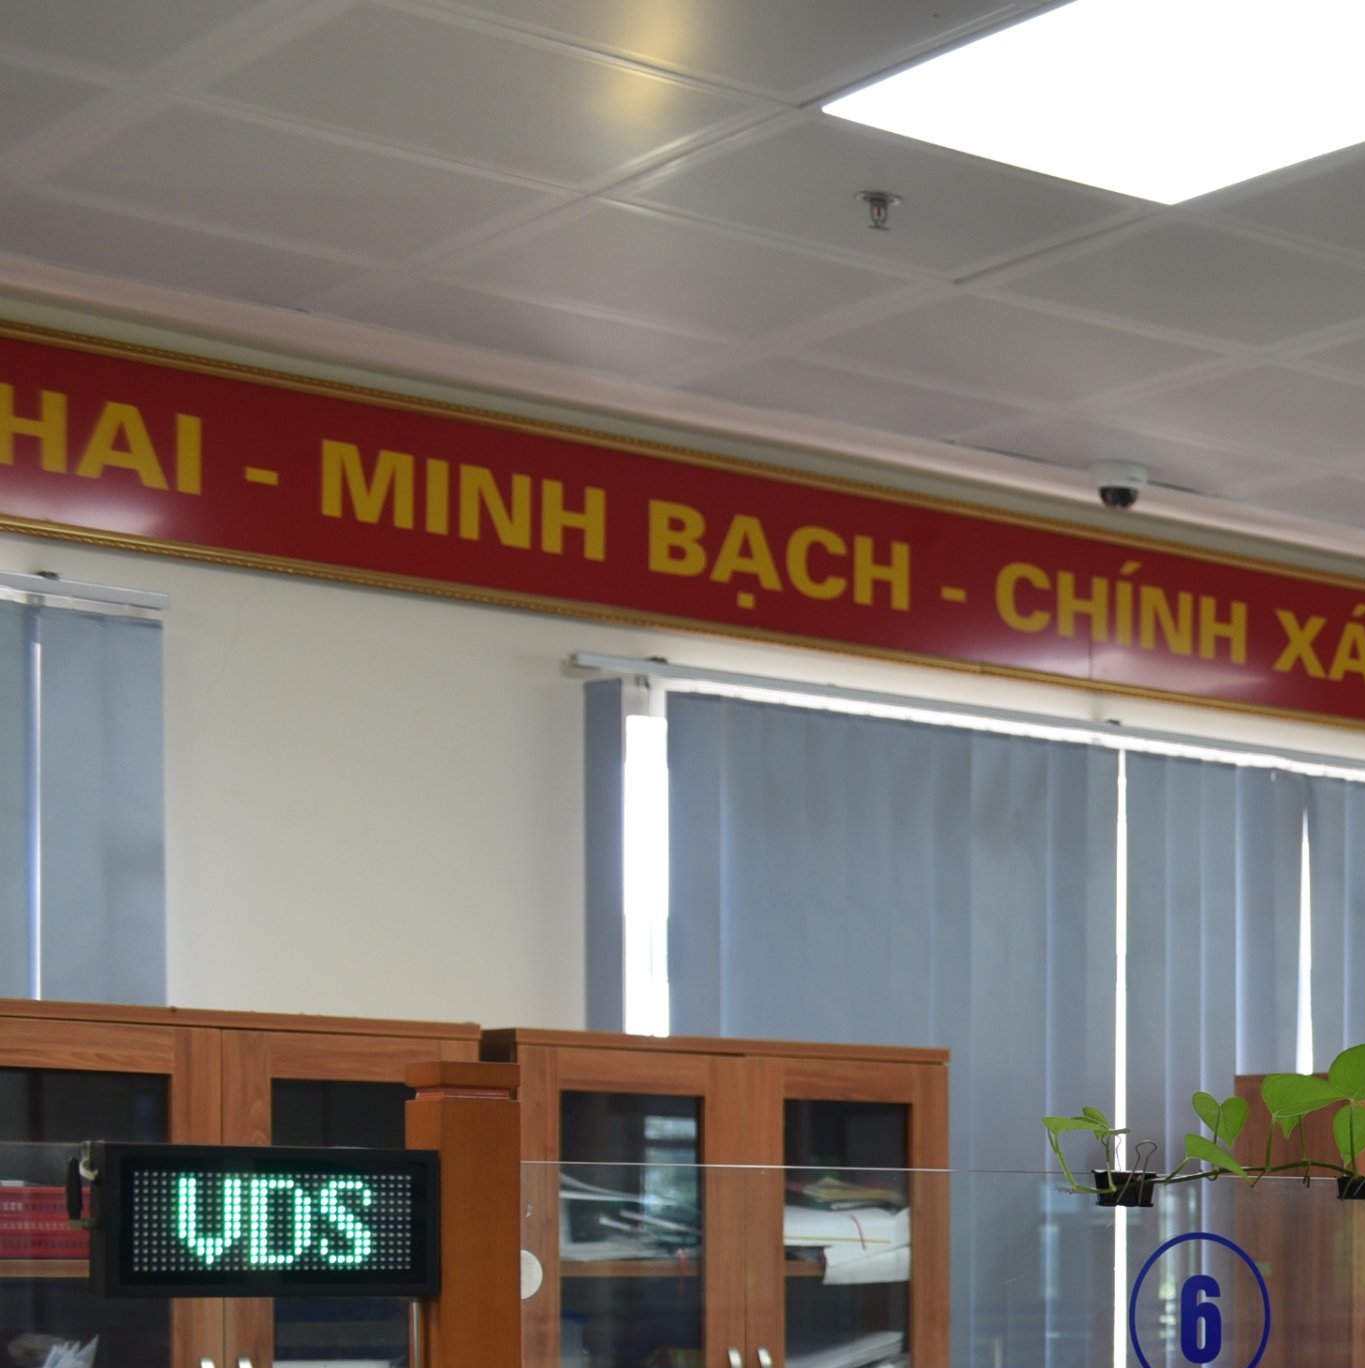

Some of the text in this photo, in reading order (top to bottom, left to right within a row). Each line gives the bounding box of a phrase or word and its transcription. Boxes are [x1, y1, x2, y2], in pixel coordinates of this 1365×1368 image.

[322, 439, 606, 562] MINH
[649, 500, 911, 609] BẠCH
[996, 558, 1247, 664] CHÍNH
[178, 1177, 372, 1265] VDS
[1180, 1274, 1223, 1365] 6
